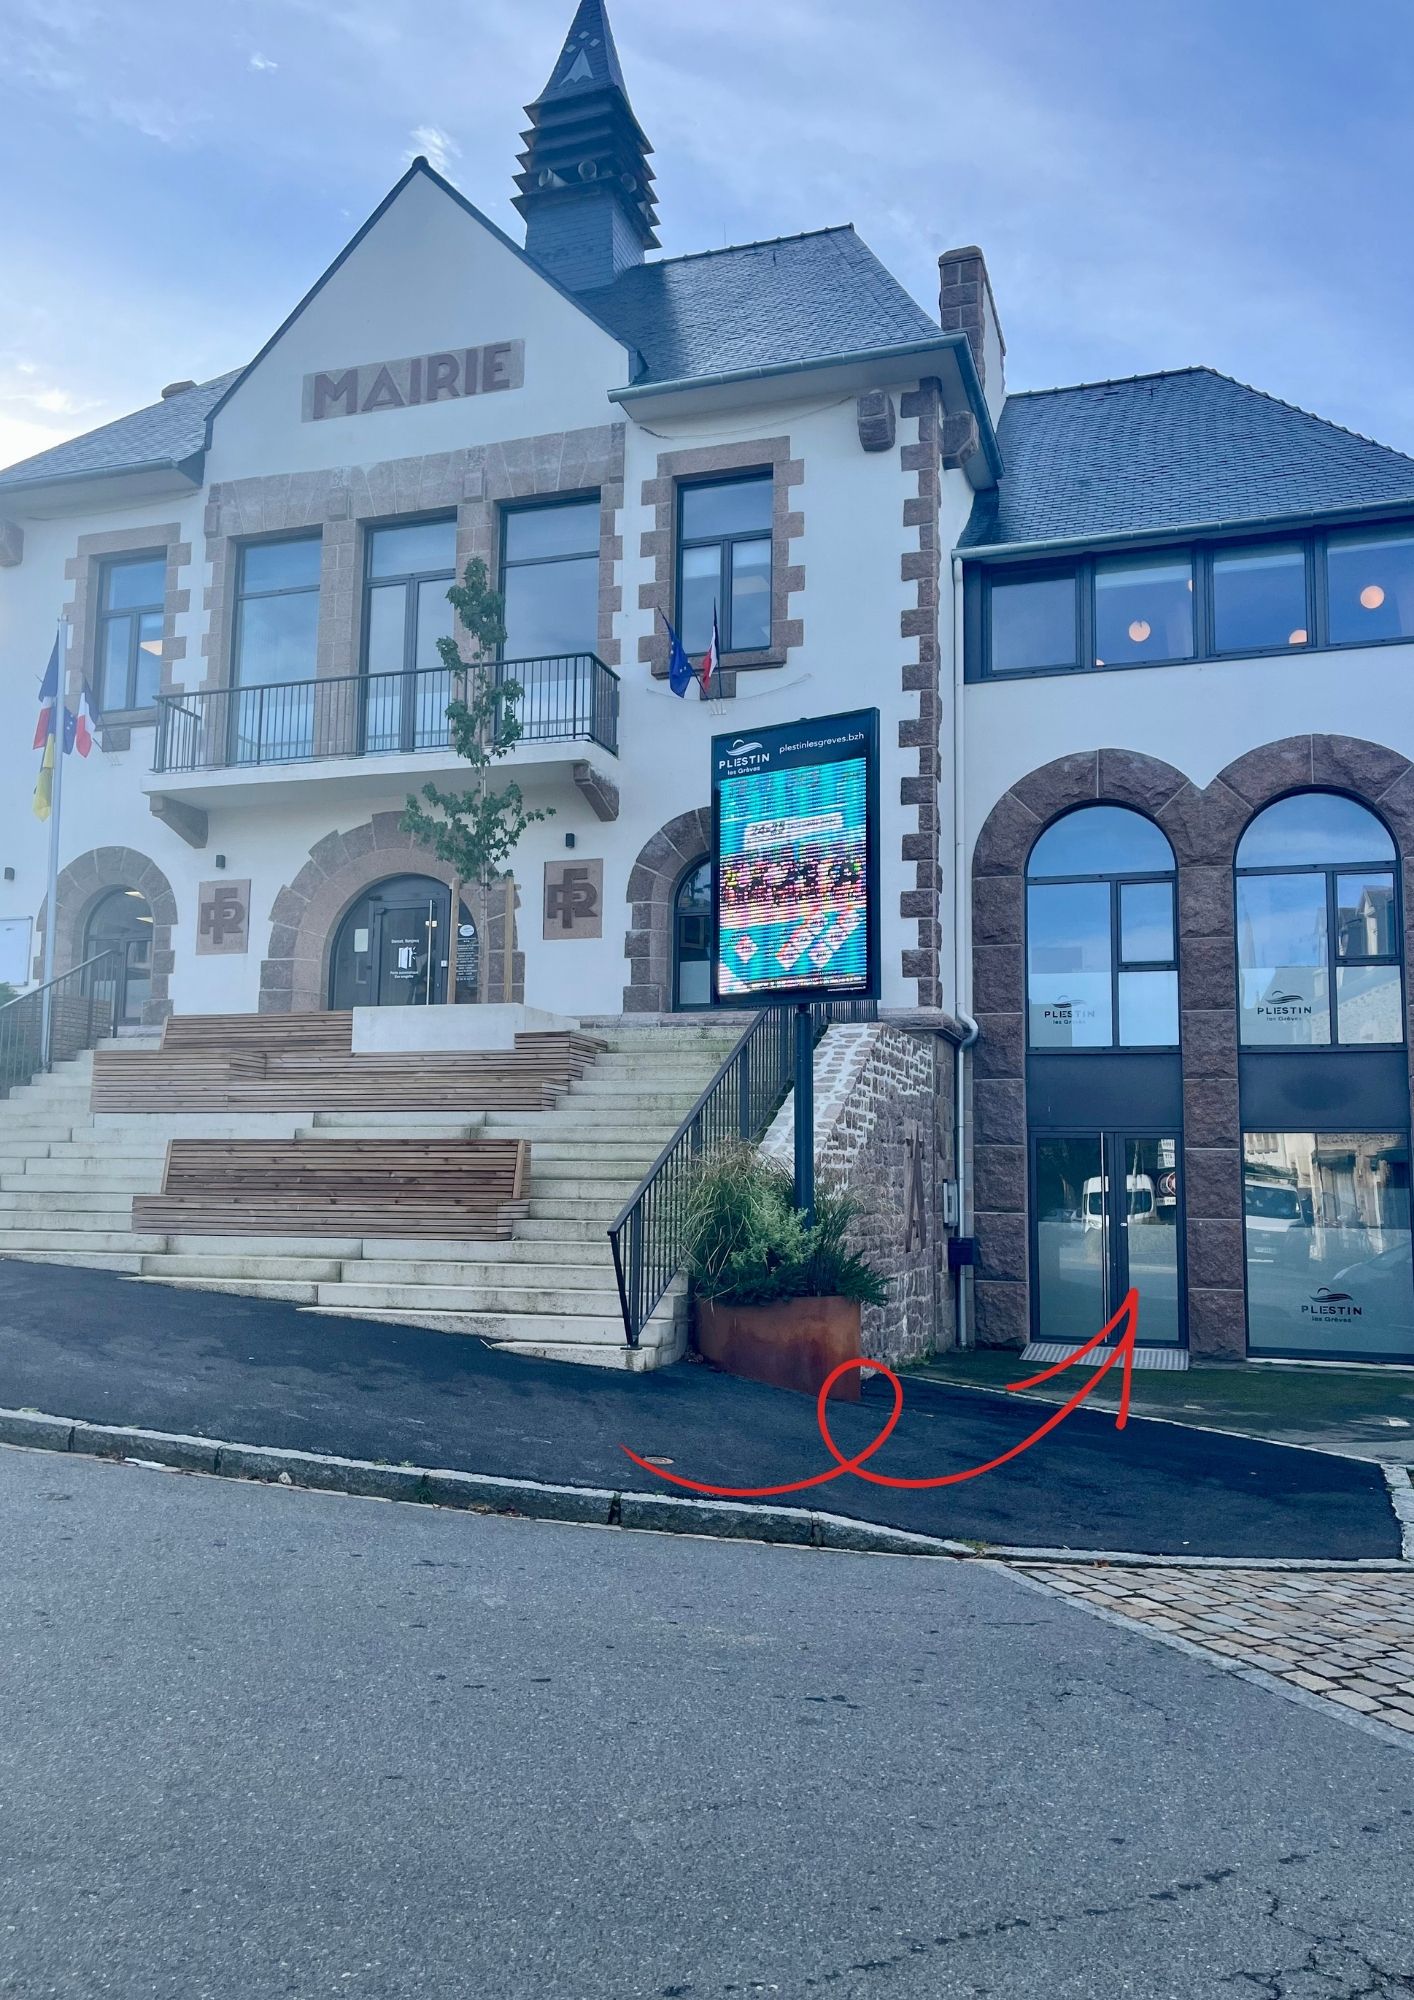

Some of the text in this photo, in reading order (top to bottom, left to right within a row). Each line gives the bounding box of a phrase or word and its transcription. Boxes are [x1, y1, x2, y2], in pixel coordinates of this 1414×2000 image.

[312, 342, 511, 420] MAIRIE
[779, 732, 865, 755] plestinlesgreves.bzh
[719, 752, 770, 769] PLESTIN
[1044, 1010, 1096, 1018] PLESTIN
[1257, 1005, 1312, 1015] PLESTIN
[1301, 1305, 1362, 1316] PLESTIN
